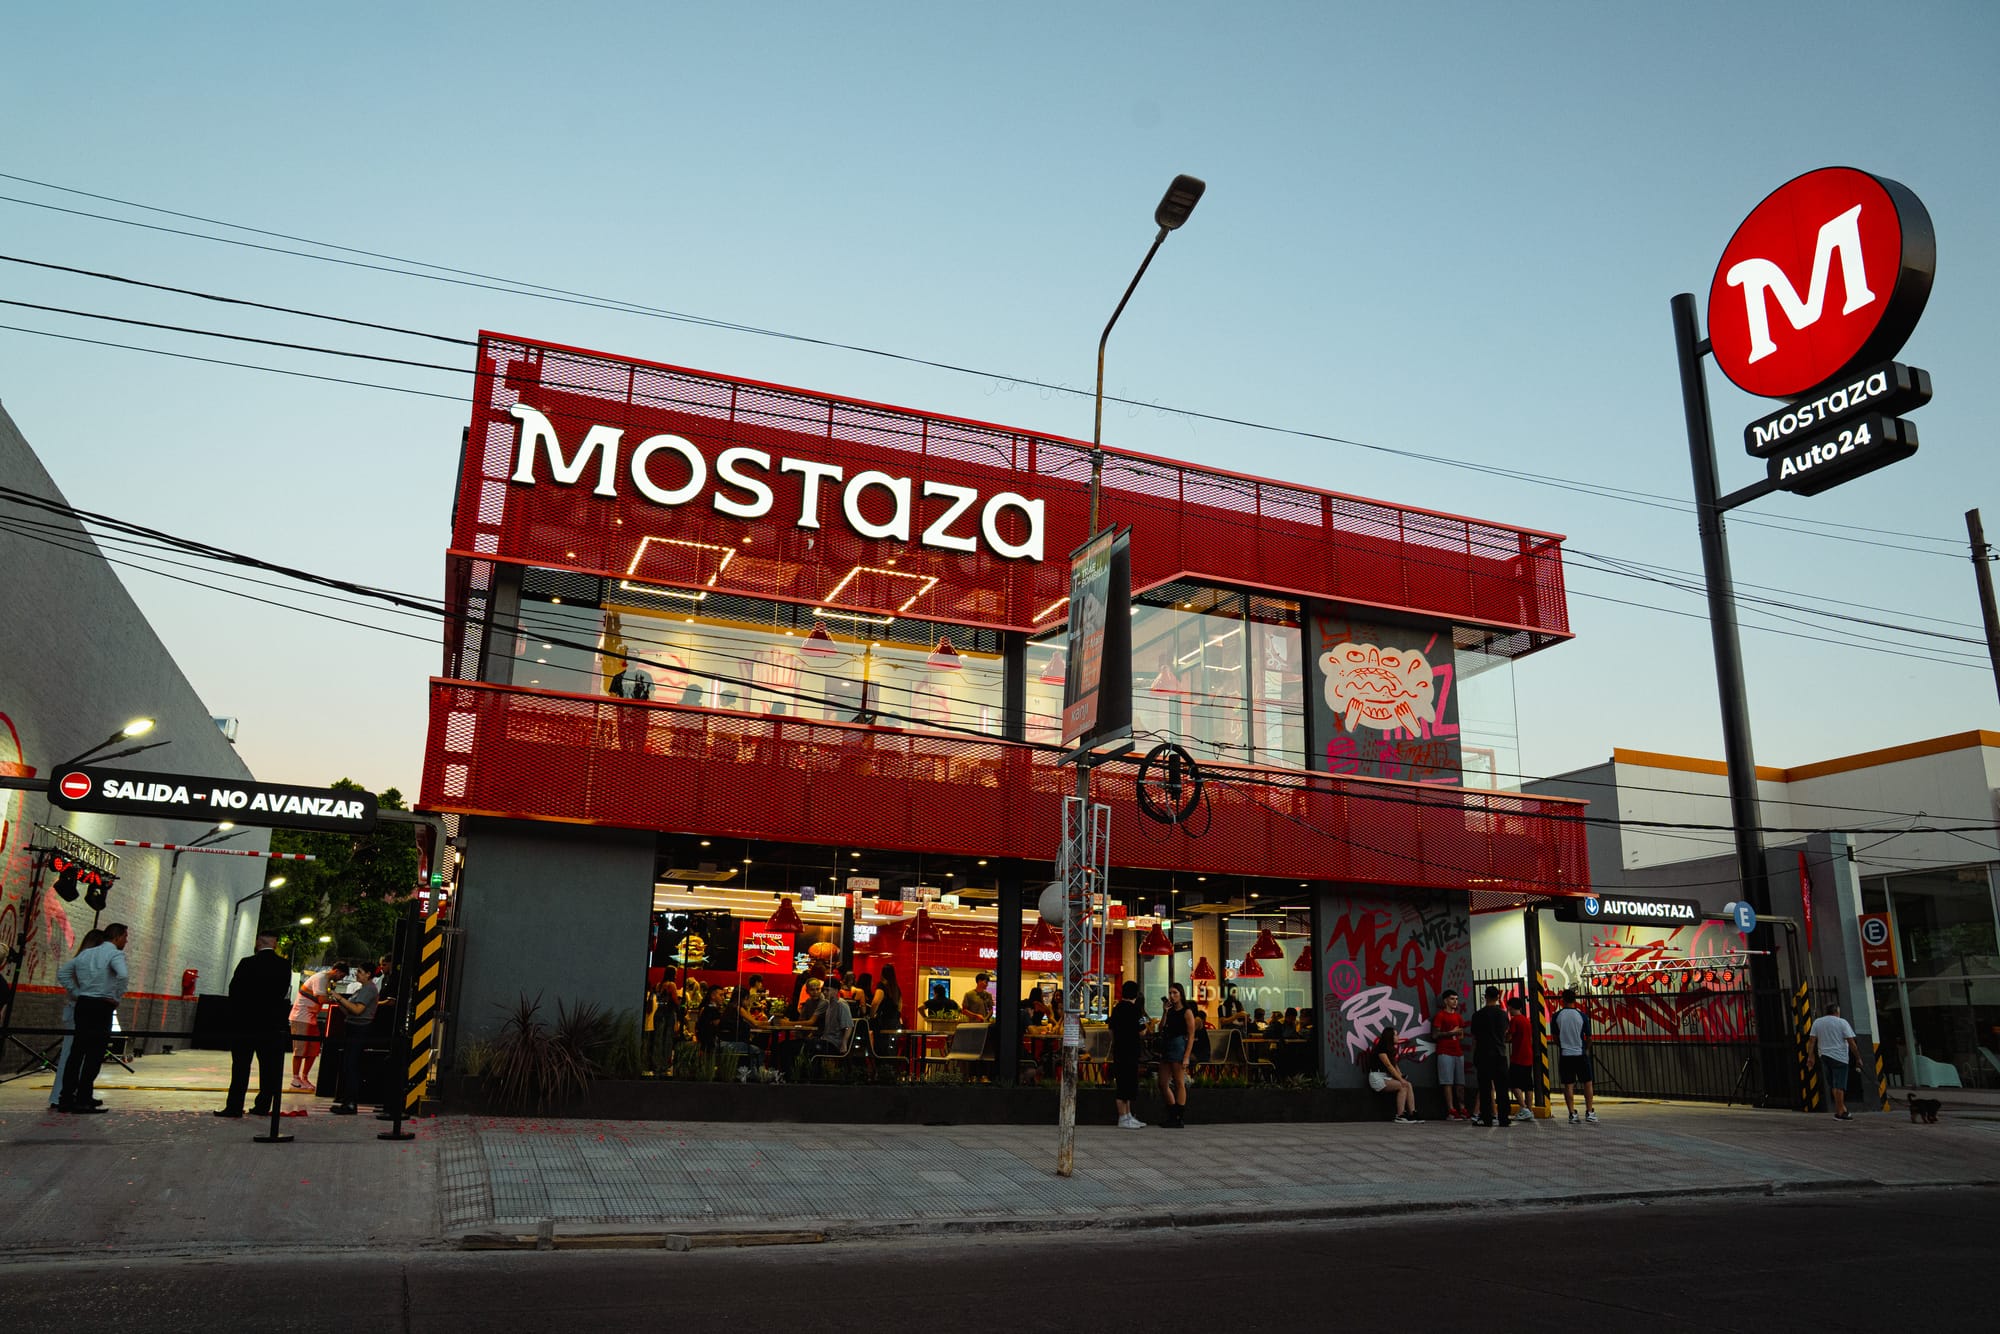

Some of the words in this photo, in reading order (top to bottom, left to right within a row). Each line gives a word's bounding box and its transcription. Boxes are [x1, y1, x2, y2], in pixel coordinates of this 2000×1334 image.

[1727, 203, 1876, 364] M
[102, 779, 190, 804] SALIDA
[210, 789, 248, 809] NO
[250, 792, 365, 820] AVANZAR
[418, 891, 448, 900] RIRS
[1603, 900, 1695, 919] AUTOMOSTAZA
[1740, 907, 1750, 927] E
[1867, 923, 1882, 940] E
[1024, 950, 1063, 961] PEDIDO
